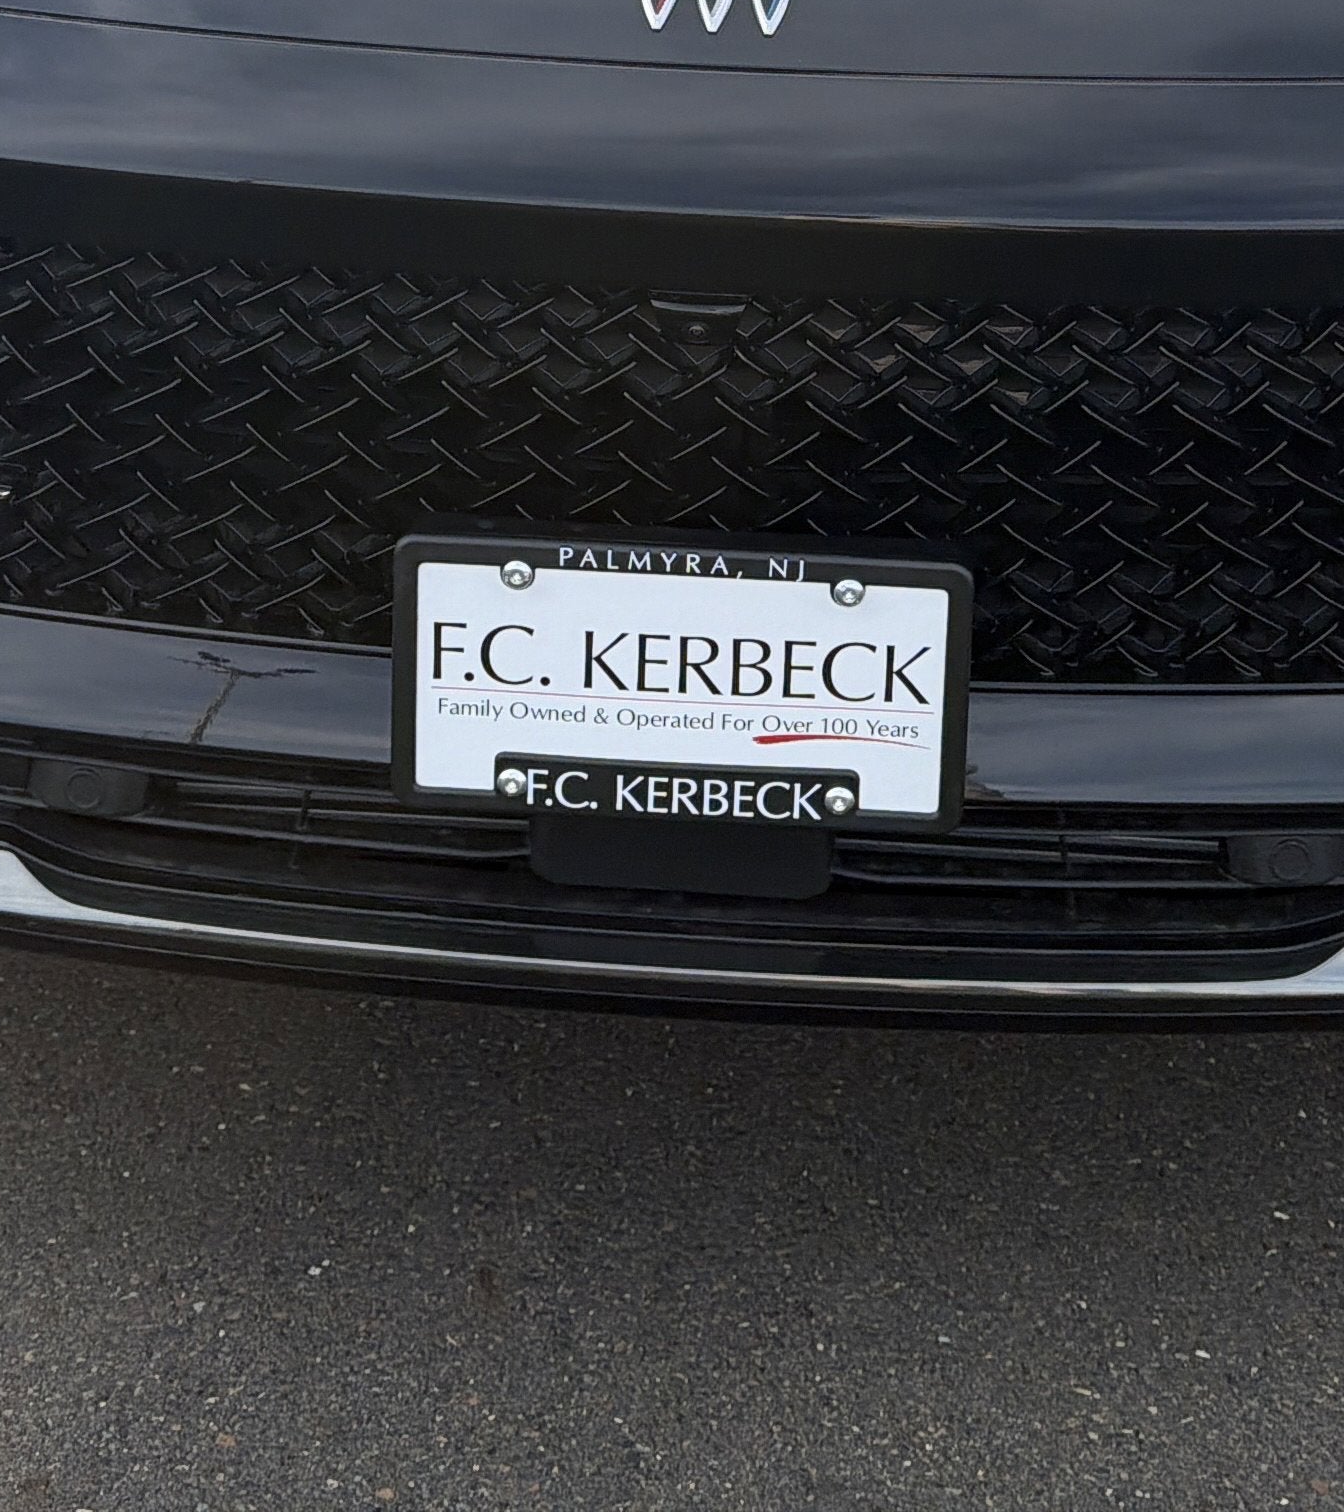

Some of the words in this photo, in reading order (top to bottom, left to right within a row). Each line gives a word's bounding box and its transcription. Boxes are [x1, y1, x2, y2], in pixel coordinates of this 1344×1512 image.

[558, 546, 743, 580] PALMYRA,
[768, 557, 806, 583] NJ
[432, 621, 551, 686] F.C.
[583, 630, 932, 706] KERBECK
[438, 697, 504, 722] Family
[509, 701, 586, 723] Owned
[593, 707, 610, 724] &
[616, 707, 715, 734] Operated
[721, 713, 755, 732] For
[761, 714, 814, 734] Over
[820, 717, 859, 735] 100
[866, 718, 920, 739] Years
[525, 768, 599, 810] F.C.
[615, 774, 823, 821] KERBECK
